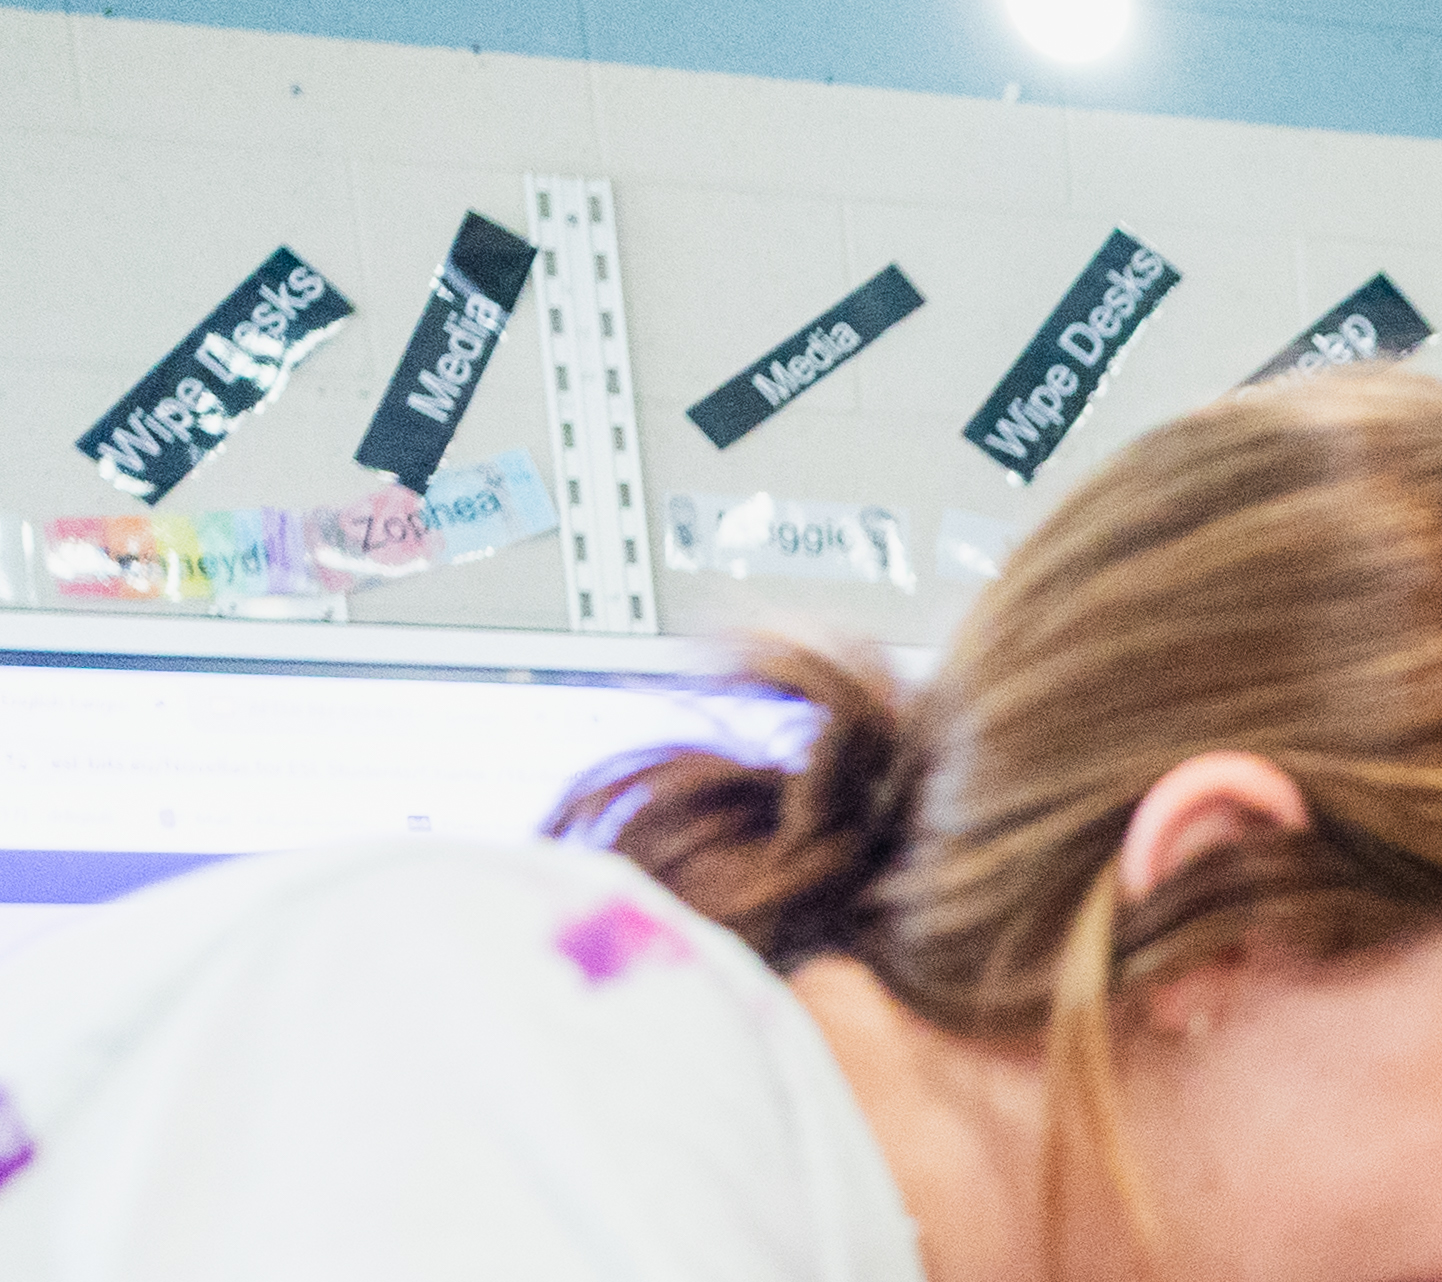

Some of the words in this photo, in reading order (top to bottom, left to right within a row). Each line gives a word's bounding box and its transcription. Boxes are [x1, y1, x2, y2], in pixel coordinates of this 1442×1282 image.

[406, 292, 502, 423] Media
[751, 318, 862, 408] Media
[984, 366, 1080, 460] Wipe
[1059, 246, 1164, 366] Desks
[99, 376, 207, 475] Wipe
